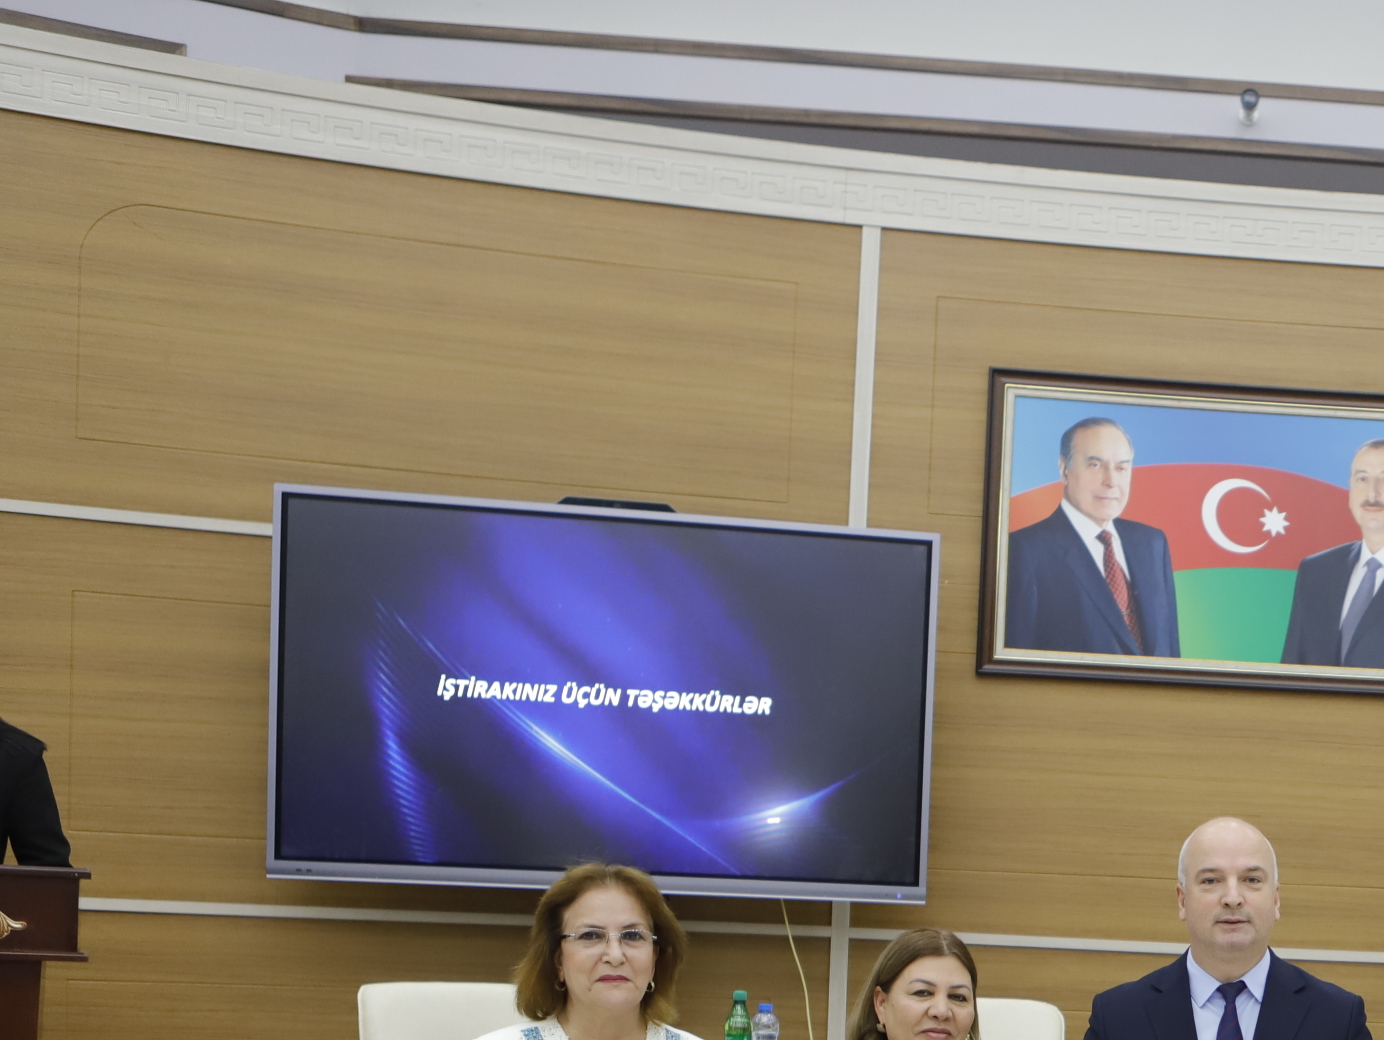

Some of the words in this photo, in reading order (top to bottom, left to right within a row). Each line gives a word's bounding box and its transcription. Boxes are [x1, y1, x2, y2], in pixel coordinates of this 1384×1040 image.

[437, 674, 557, 702] İŞTİRAKINIZ
[561, 681, 621, 708] ÜÇÜN
[626, 689, 772, 715] TƏŞƏKKÜRLƏR
